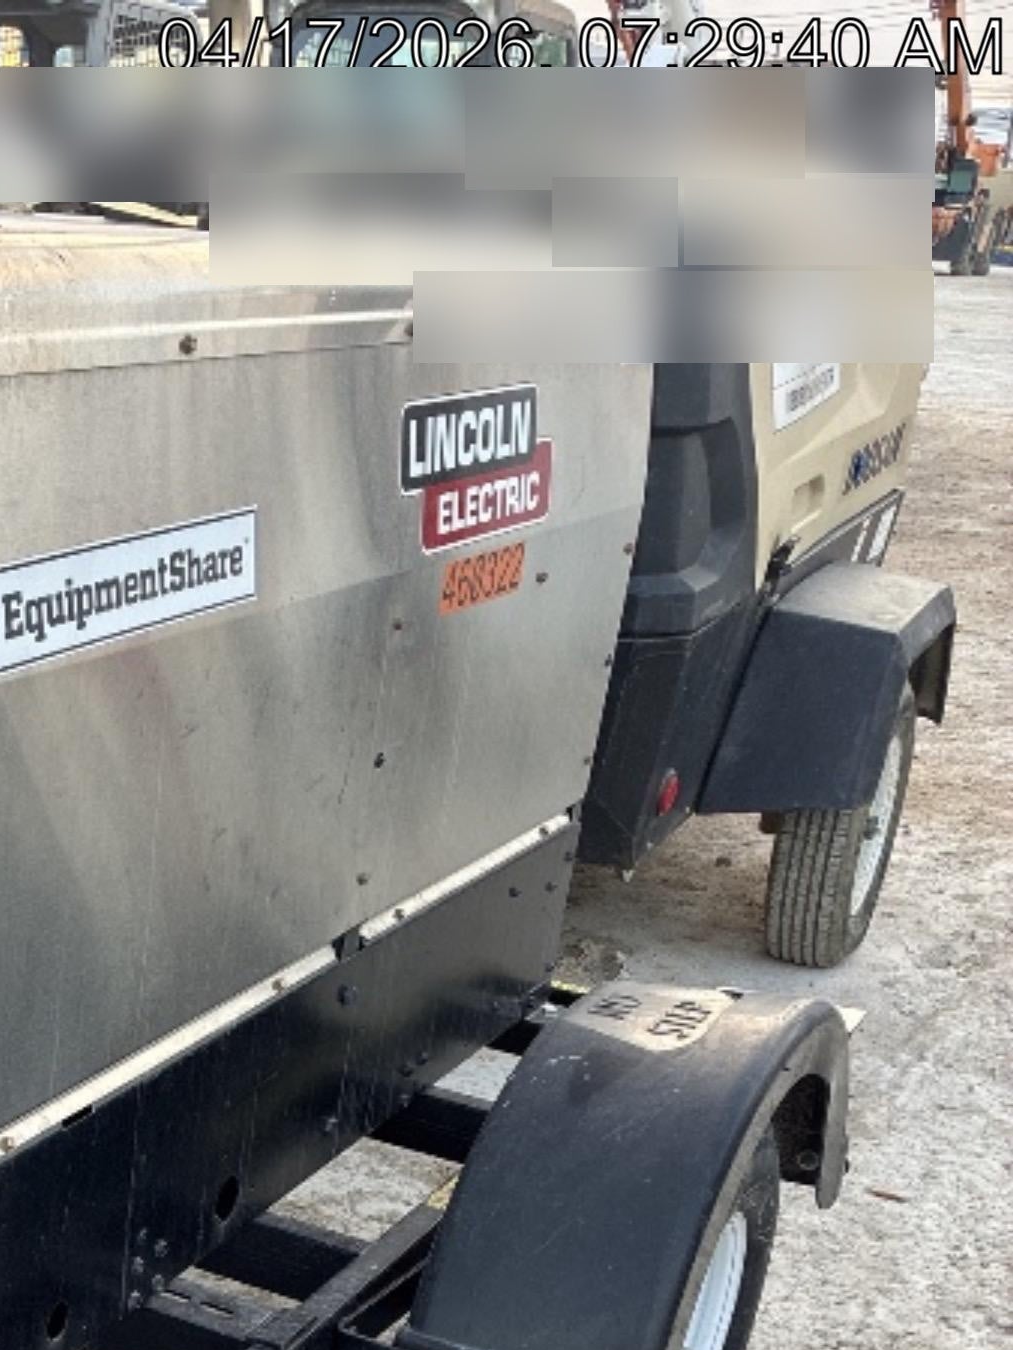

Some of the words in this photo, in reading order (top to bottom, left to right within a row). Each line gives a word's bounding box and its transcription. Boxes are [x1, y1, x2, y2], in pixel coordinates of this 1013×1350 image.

[409, 400, 532, 478] LINCOLN
[437, 471, 541, 535] ELECTRIC
[1, 545, 244, 642] EquipmentShare
